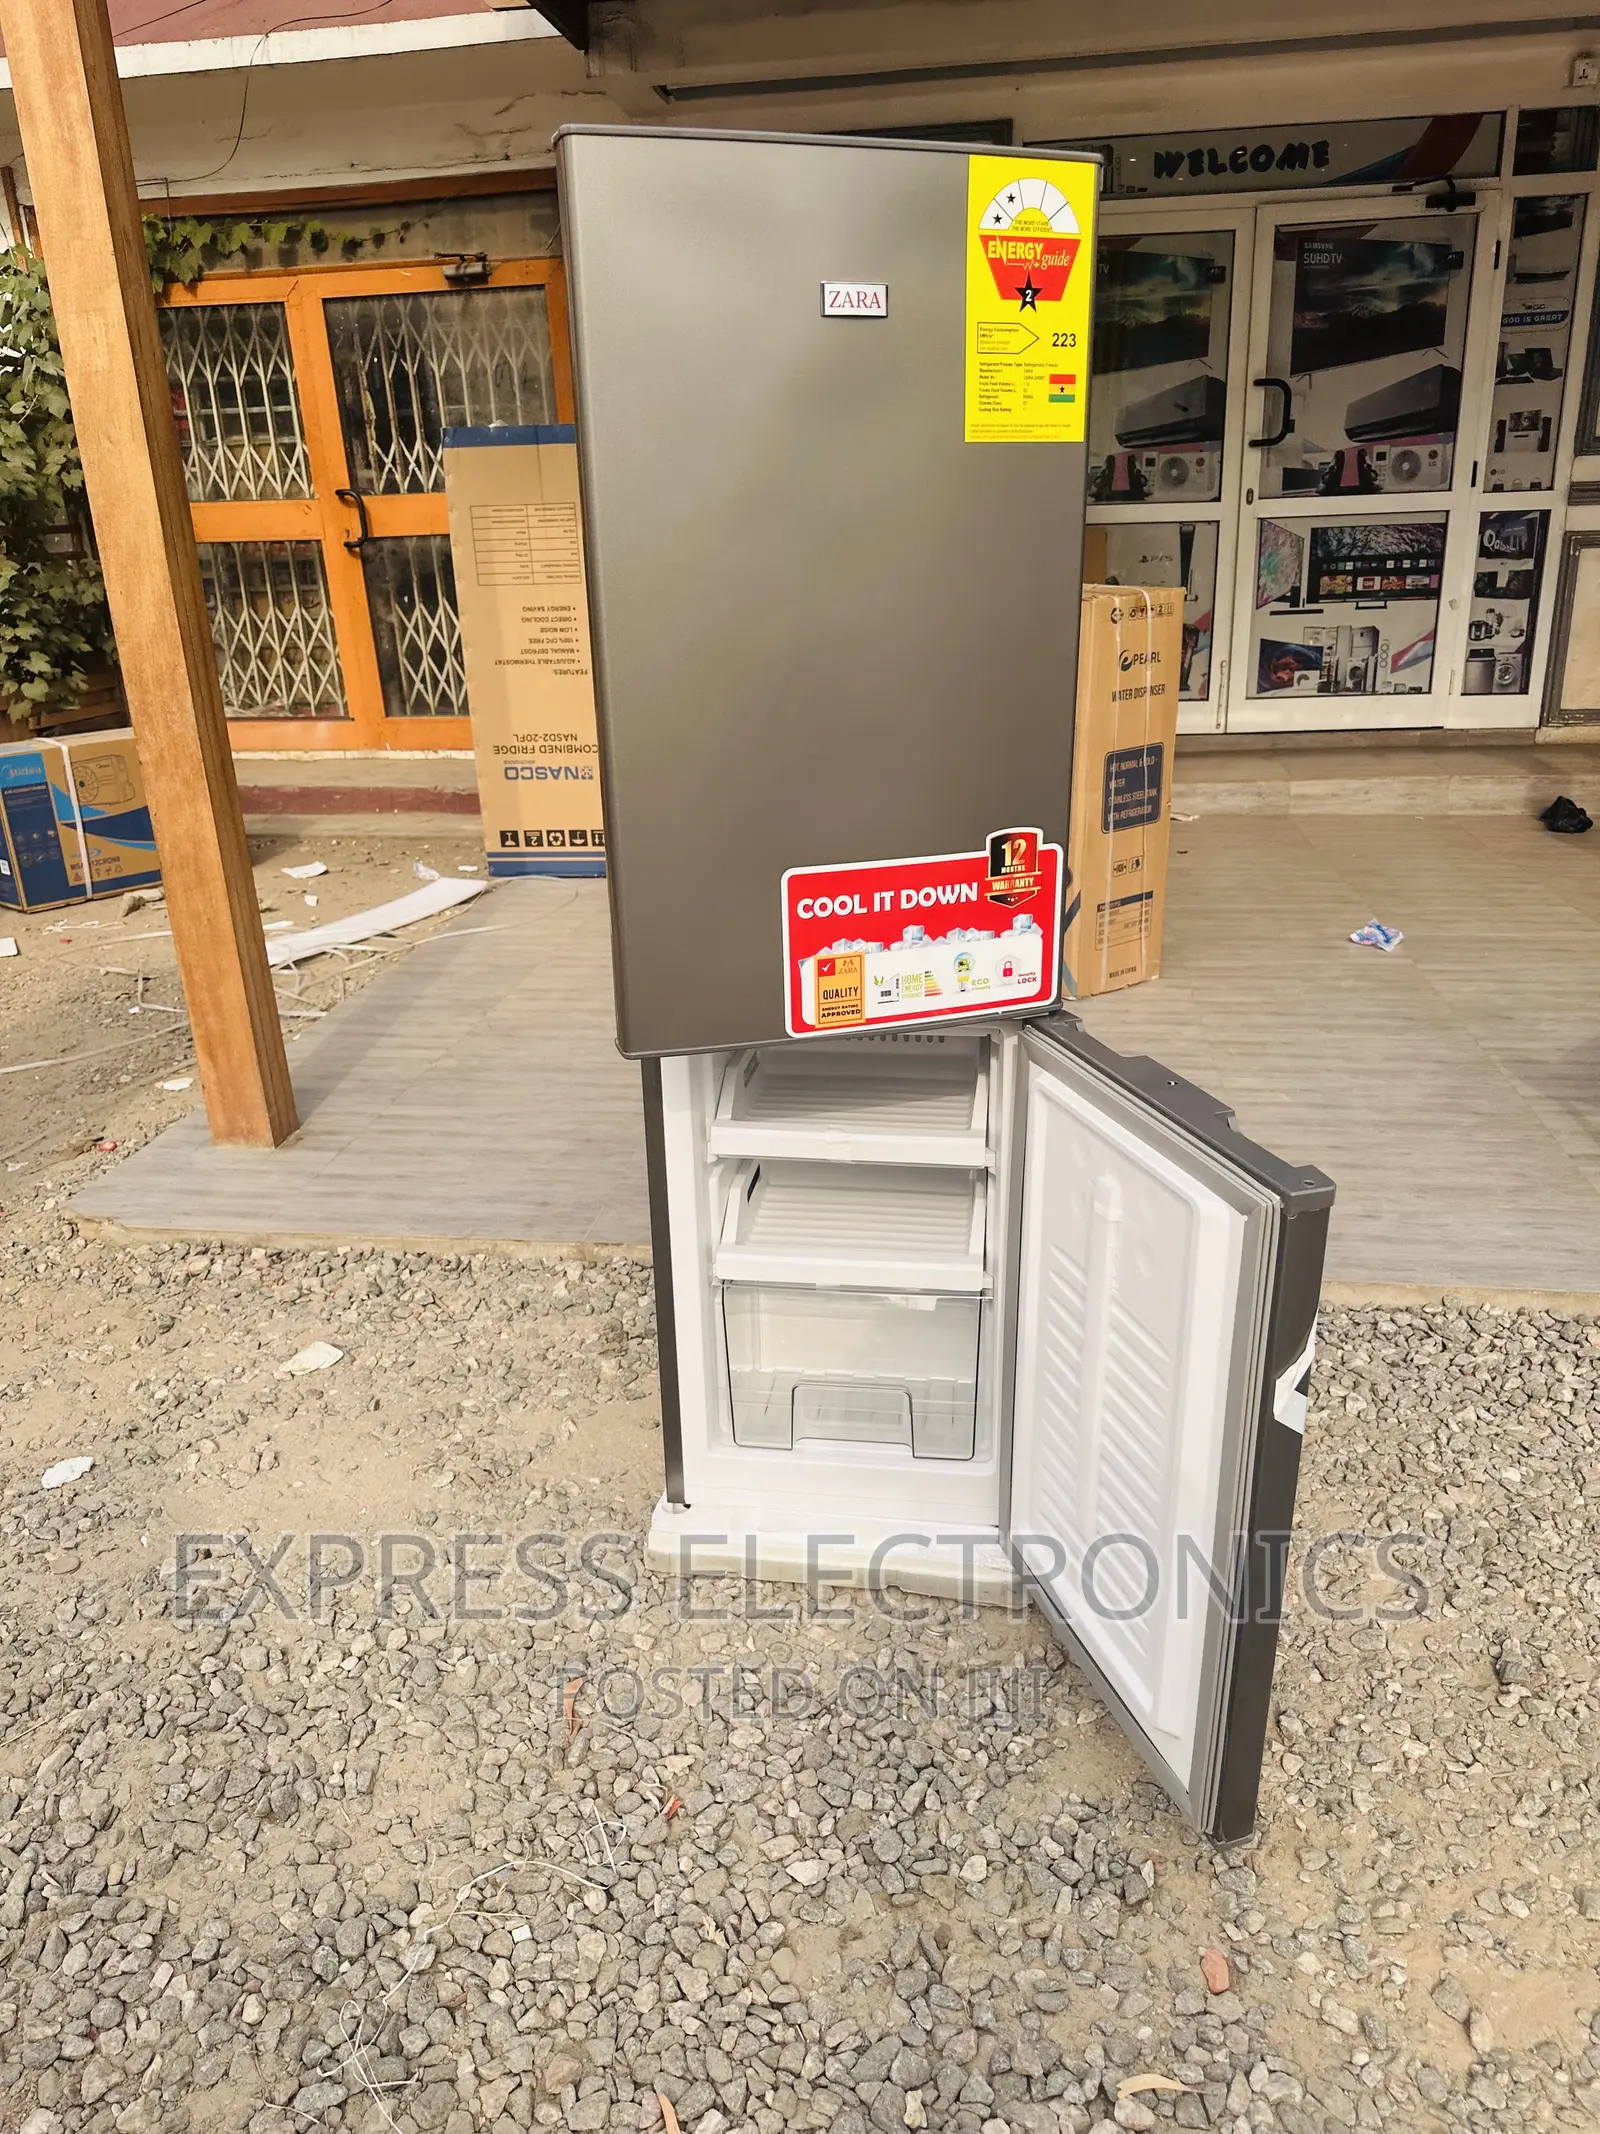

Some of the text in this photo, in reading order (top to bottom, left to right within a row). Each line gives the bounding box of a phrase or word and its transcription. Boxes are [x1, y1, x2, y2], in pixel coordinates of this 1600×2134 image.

[1153, 139, 1330, 179] WELCOME
[1303, 241, 1334, 250] SAMSUNG
[987, 236, 1071, 271] ENERGY guide
[828, 290, 882, 309] ZARA
[1025, 289, 1032, 302] 2
[1502, 316, 1521, 324] GOD
[1522, 315, 1531, 323] IS
[1051, 332, 1077, 347] 223
[1133, 684, 1166, 699] DISPNSER
[512, 733, 578, 743] NASD2-20FL
[493, 744, 599, 755] COMBINED FRIDGE
[504, 766, 579, 781] NASCO
[1001, 838, 1027, 866] 12
[1001, 864, 1026, 874] MONTHS
[992, 876, 1035, 891] WARRANTY
[796, 881, 979, 920] COOL IT DOWN
[838, 966, 858, 975] ZARA
[901, 972, 924, 986] HOME
[971, 977, 990, 986] ECO
[1017, 976, 1037, 985] LOCK
[822, 986, 859, 1000] QUALITY
[901, 983, 924, 994] ENERGY
[820, 1008, 861, 1019] APPROVED
